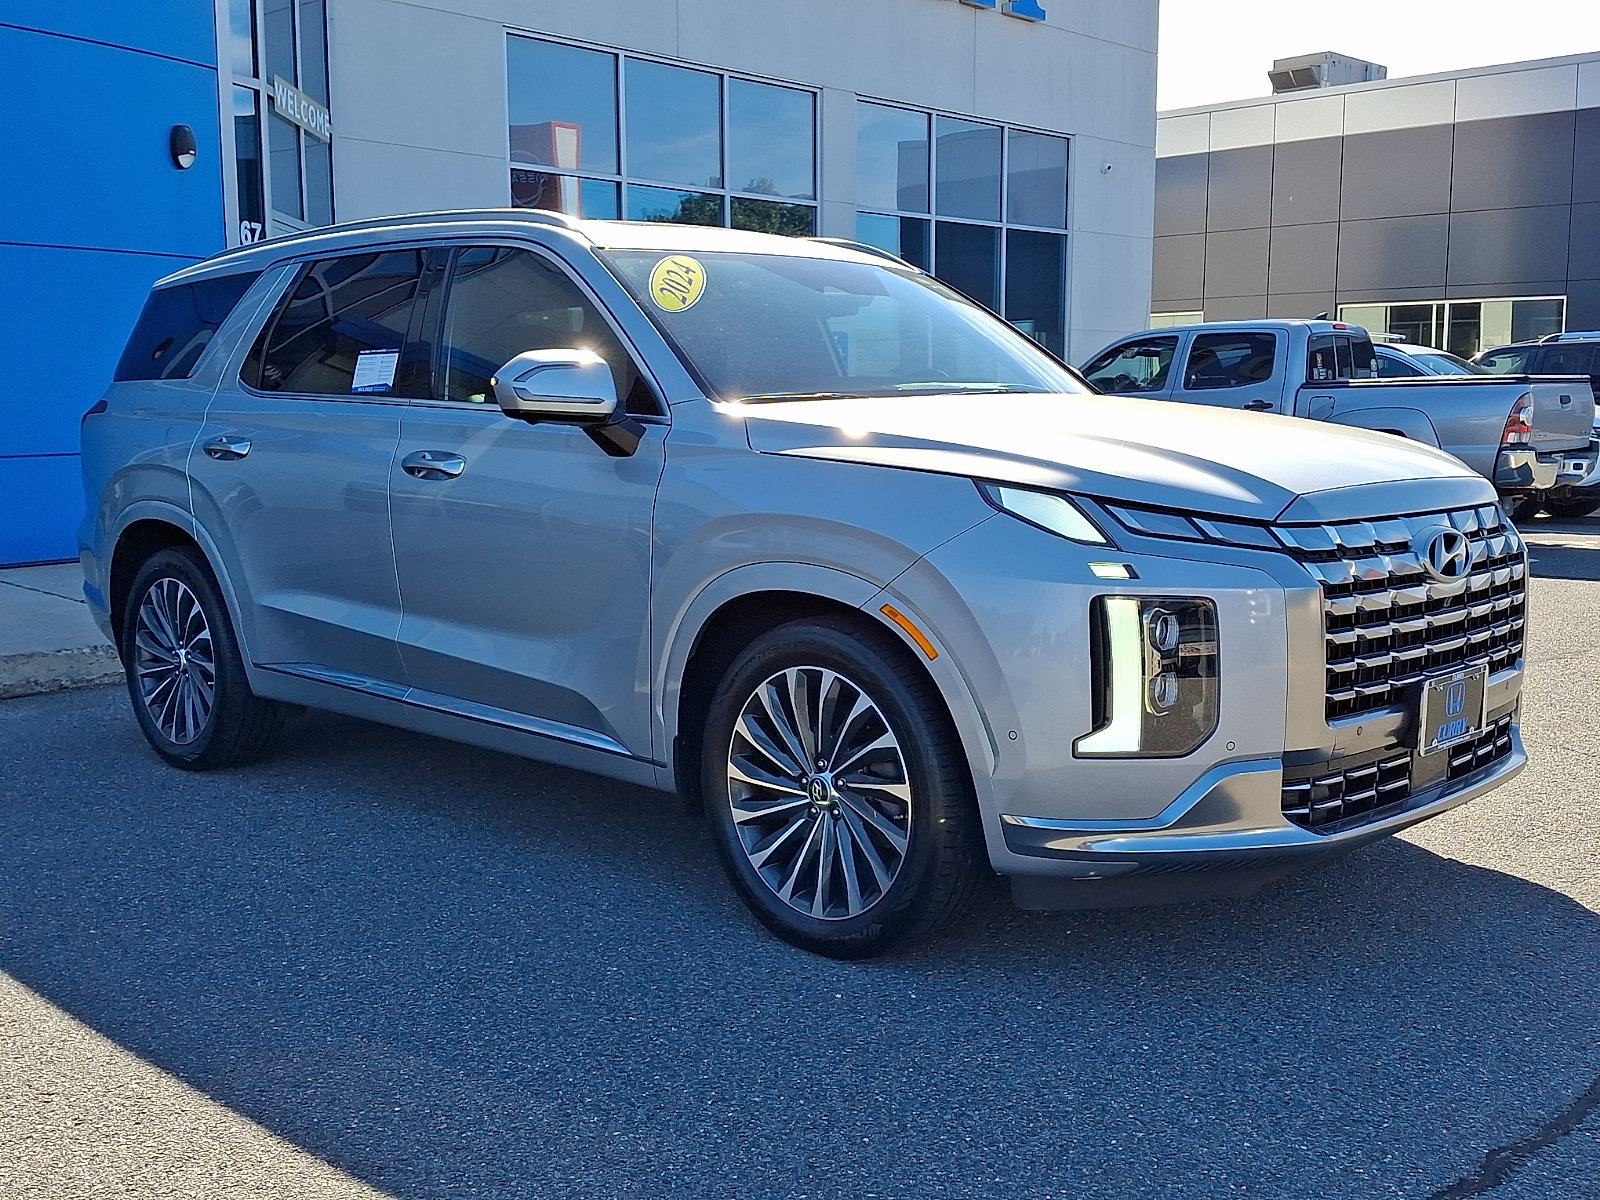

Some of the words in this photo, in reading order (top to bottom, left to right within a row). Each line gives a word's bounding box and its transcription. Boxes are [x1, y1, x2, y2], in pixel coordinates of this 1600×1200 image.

[275, 81, 330, 137] WELCOME
[240, 220, 262, 246] 67
[659, 259, 696, 306] 2024
[1437, 717, 1469, 742] CURRY
